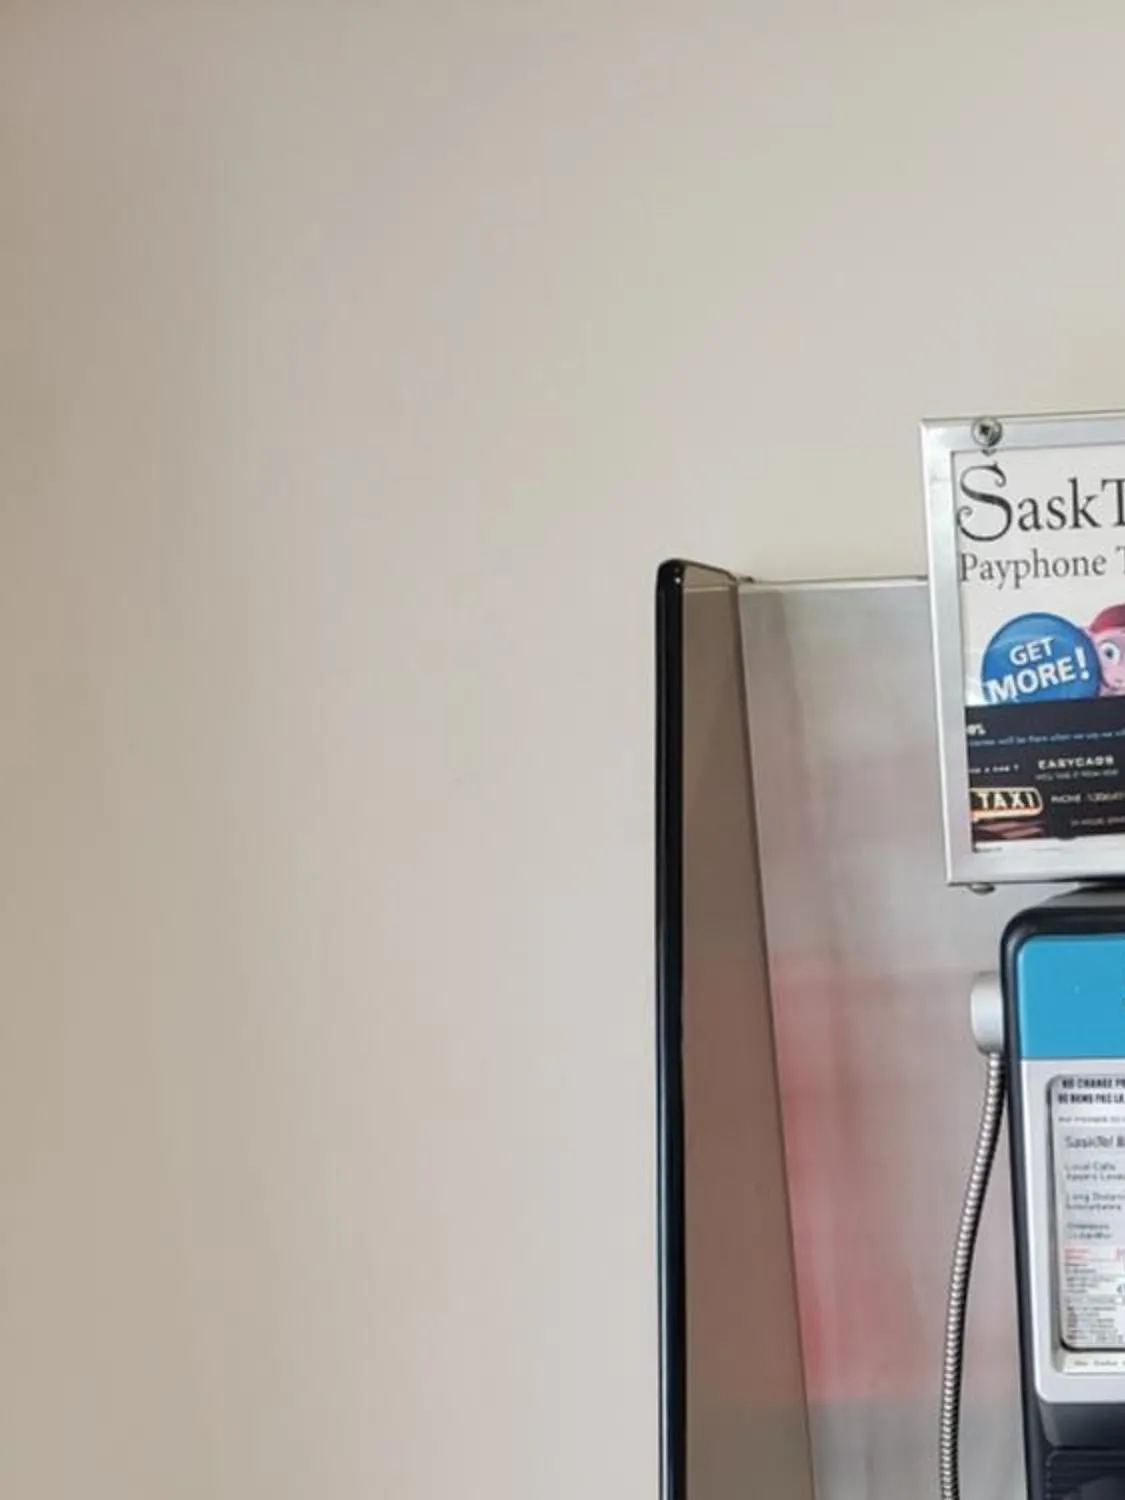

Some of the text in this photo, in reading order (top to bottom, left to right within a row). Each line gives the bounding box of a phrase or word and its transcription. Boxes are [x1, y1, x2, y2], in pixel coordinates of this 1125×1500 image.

[960, 549, 1107, 591] Payphone
[1009, 637, 1055, 666] GET
[984, 647, 1090, 703] MORE!
[1037, 755, 1114, 770] EASYCABS
[976, 792, 1035, 809] TAXI
[1077, 1078, 1113, 1089] CHANGE
